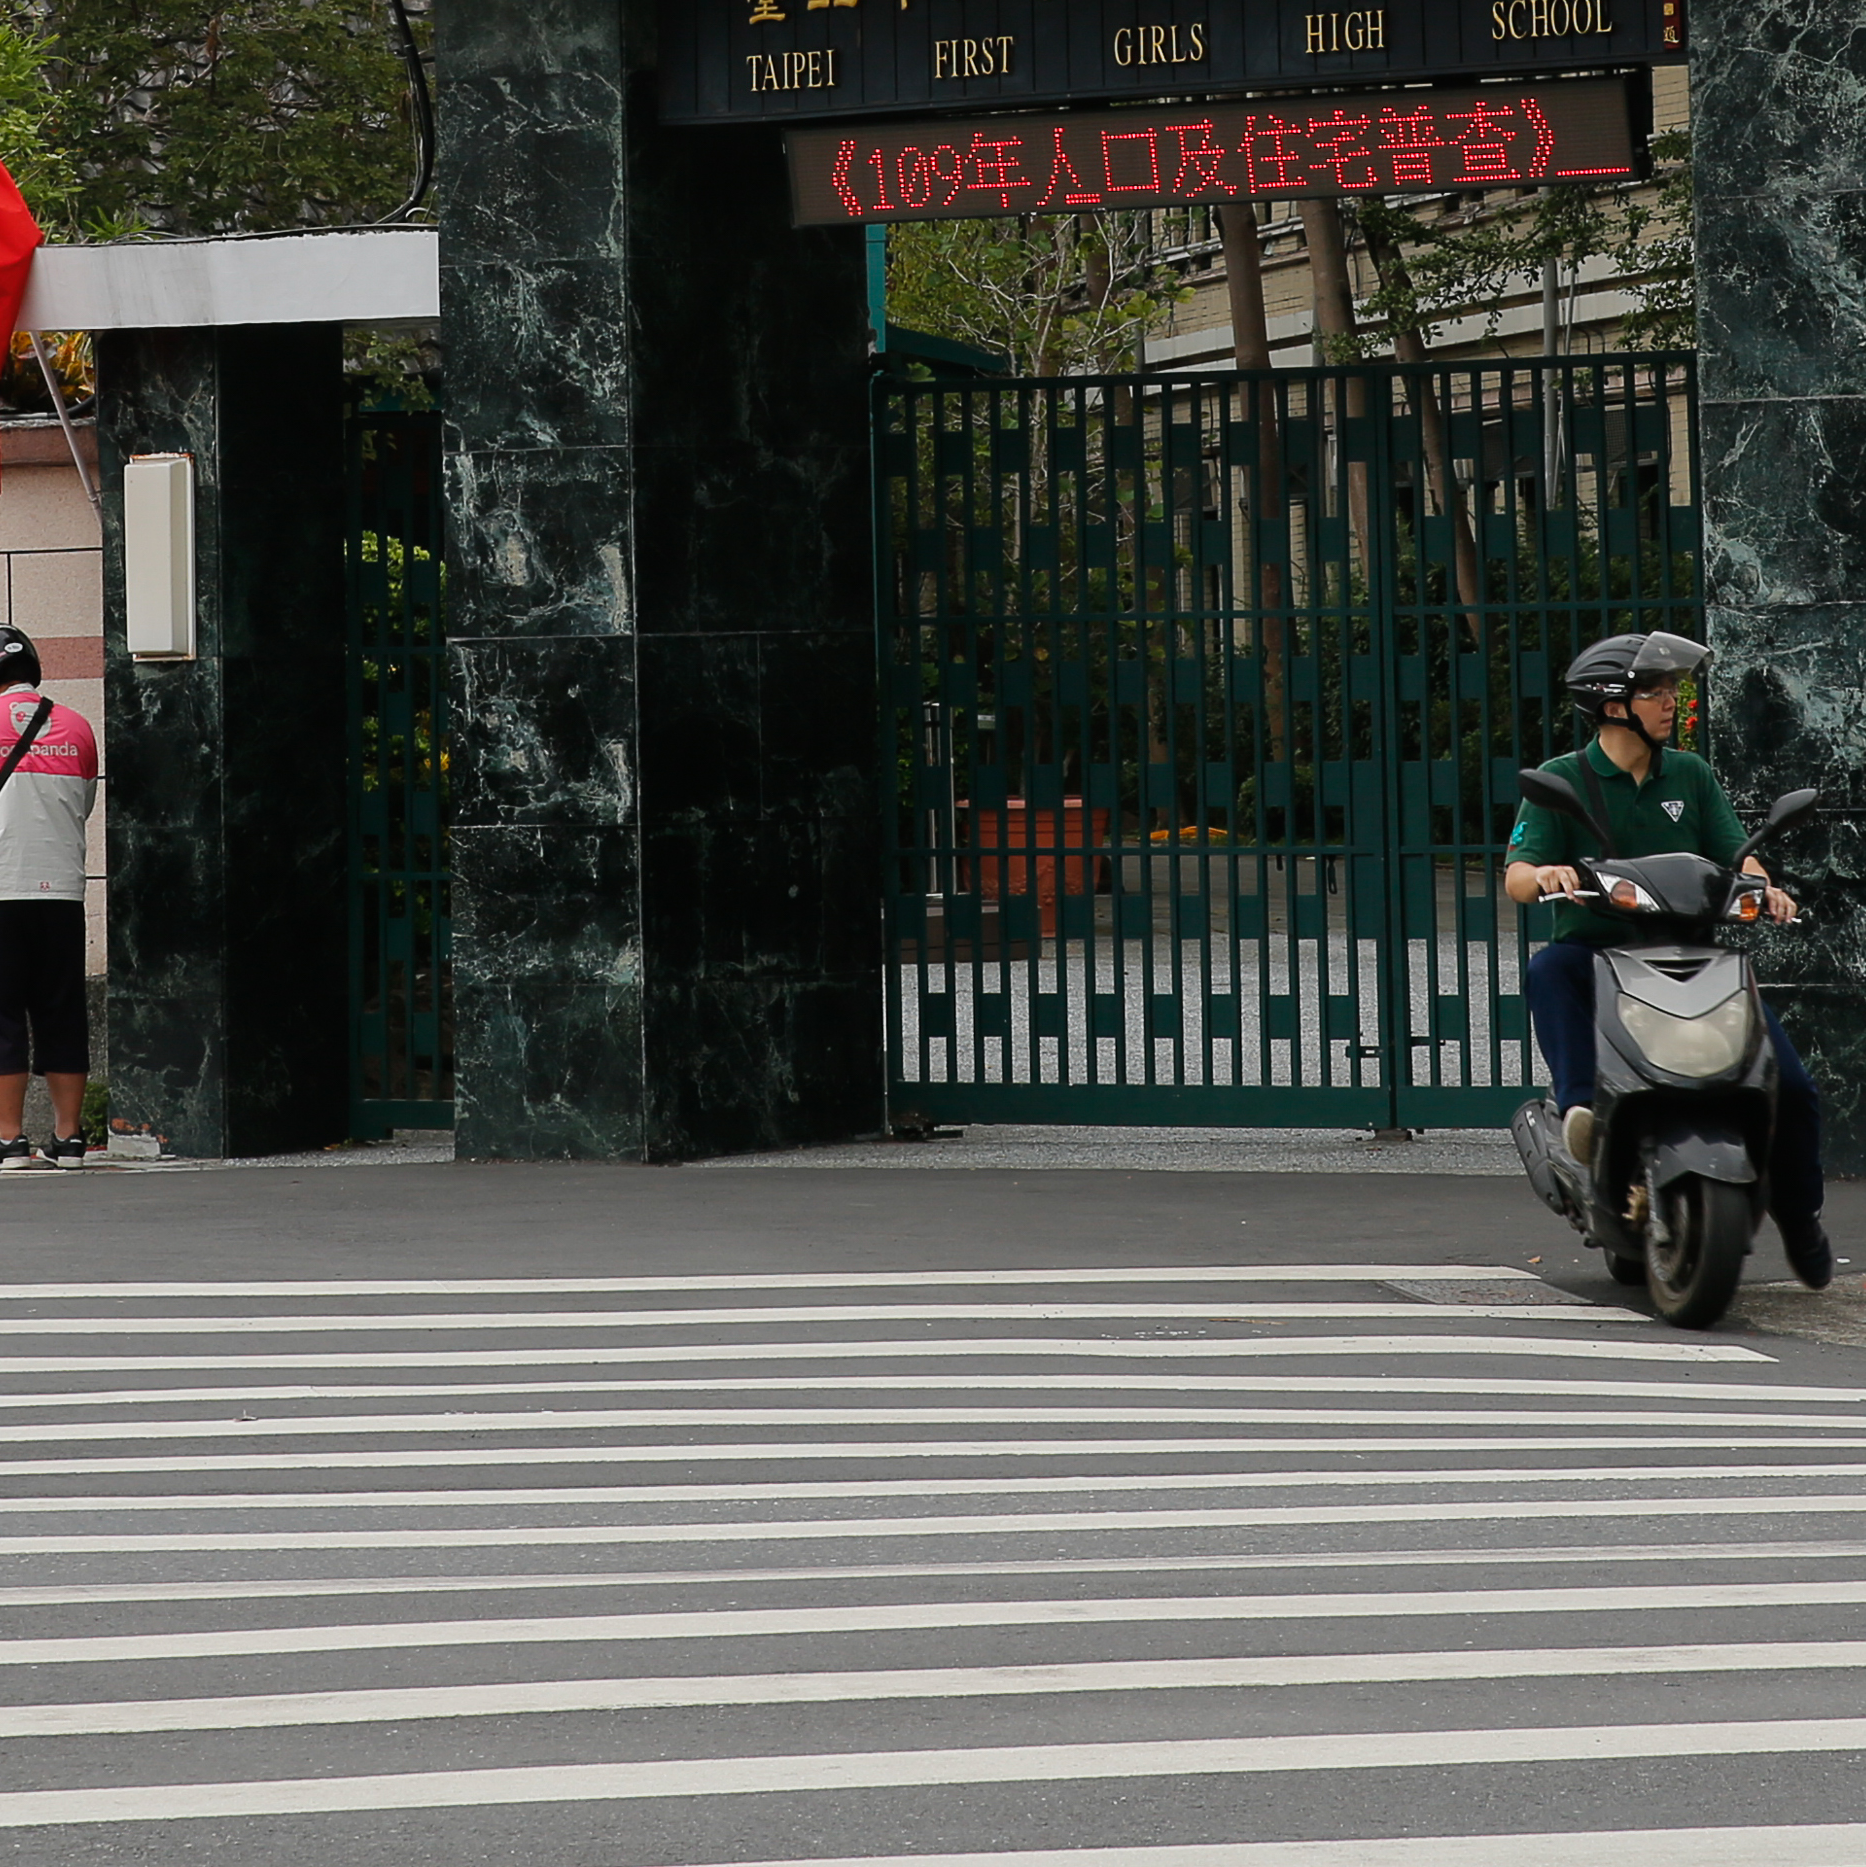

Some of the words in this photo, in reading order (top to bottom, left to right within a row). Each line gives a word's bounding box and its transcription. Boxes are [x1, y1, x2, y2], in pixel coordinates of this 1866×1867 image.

[746, 48, 836, 92] TAIPEI
[934, 35, 1014, 79] FIRST
[1114, 22, 1204, 67] GIRLS
[1305, 9, 1385, 54] HIGH
